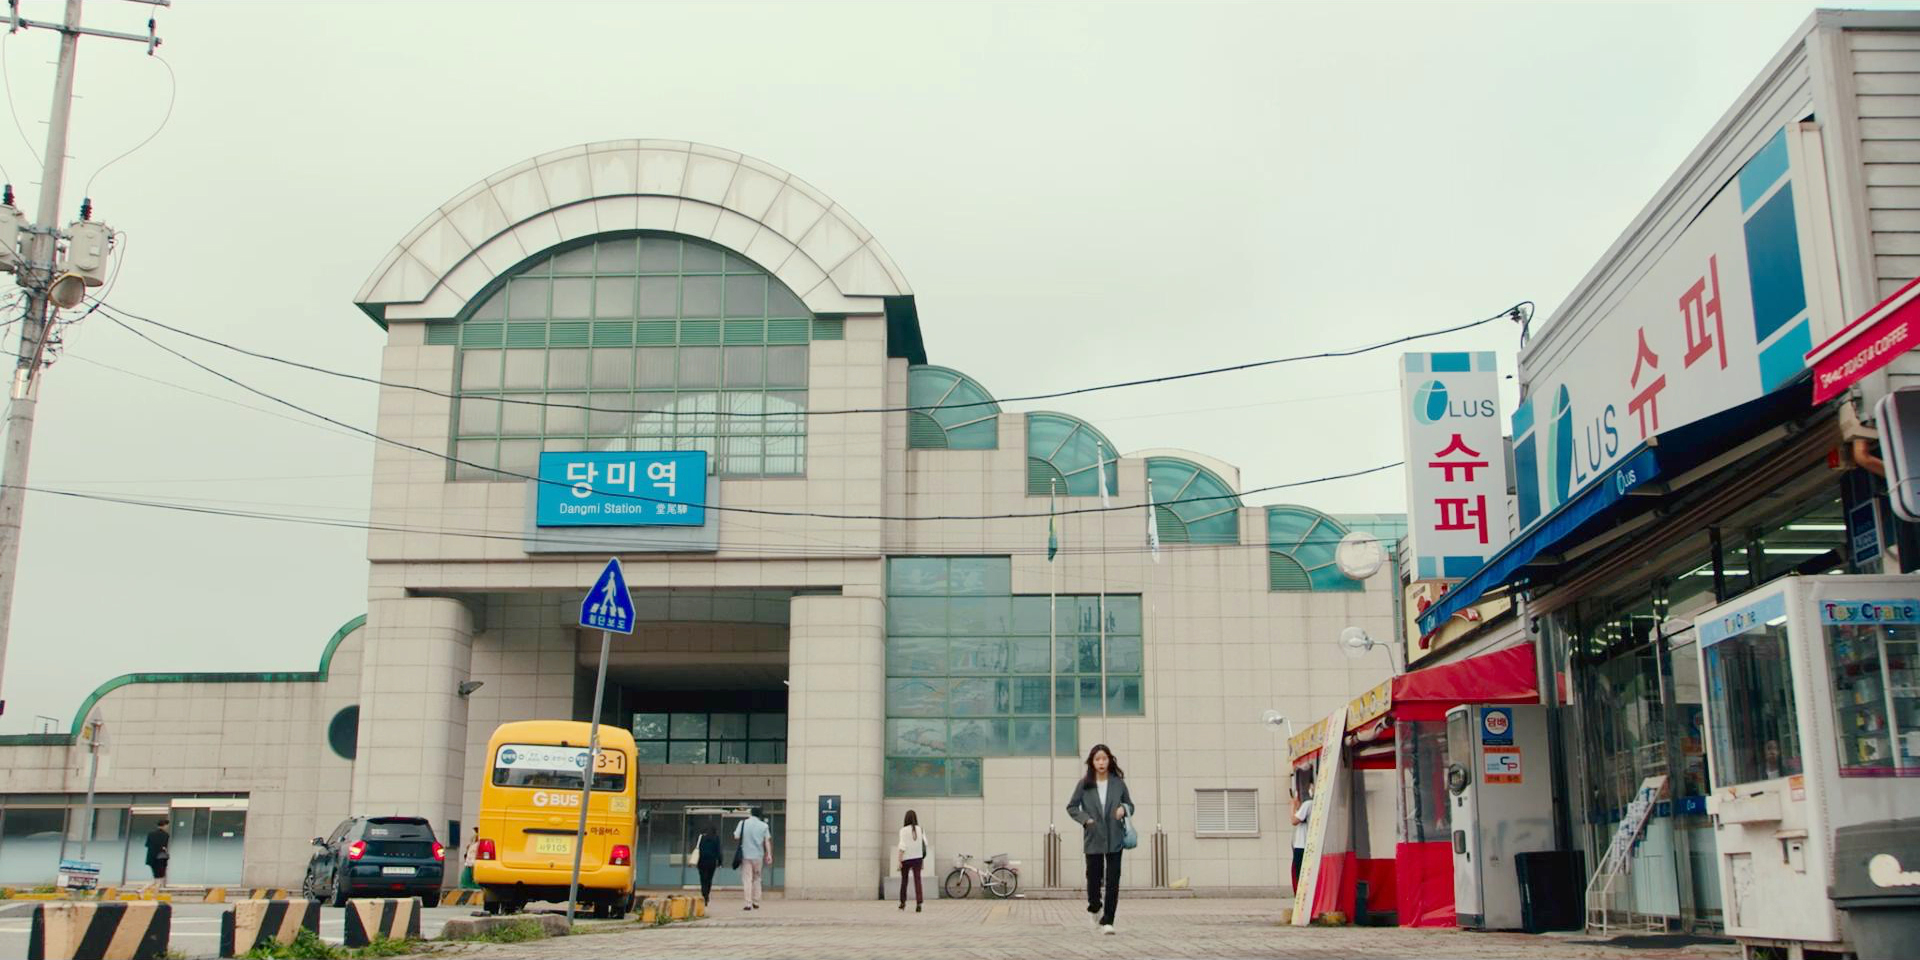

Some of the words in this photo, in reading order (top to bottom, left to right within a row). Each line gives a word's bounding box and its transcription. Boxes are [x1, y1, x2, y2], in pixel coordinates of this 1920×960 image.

[1628, 253, 1728, 440] 슈퍼
[566, 460, 676, 499] 당미역
[1428, 433, 1489, 544] 슈퍼
[559, 503, 600, 516] Dangmi
[604, 503, 642, 515] Station
[1825, 603, 1857, 621] Toy
[1861, 603, 1913, 619] Crane
[1487, 717, 1507, 728] 담배
[597, 754, 622, 769] 3-1
[550, 793, 580, 806] BUS
[827, 798, 832, 809] 1
[590, 826, 620, 836] 마을버스
